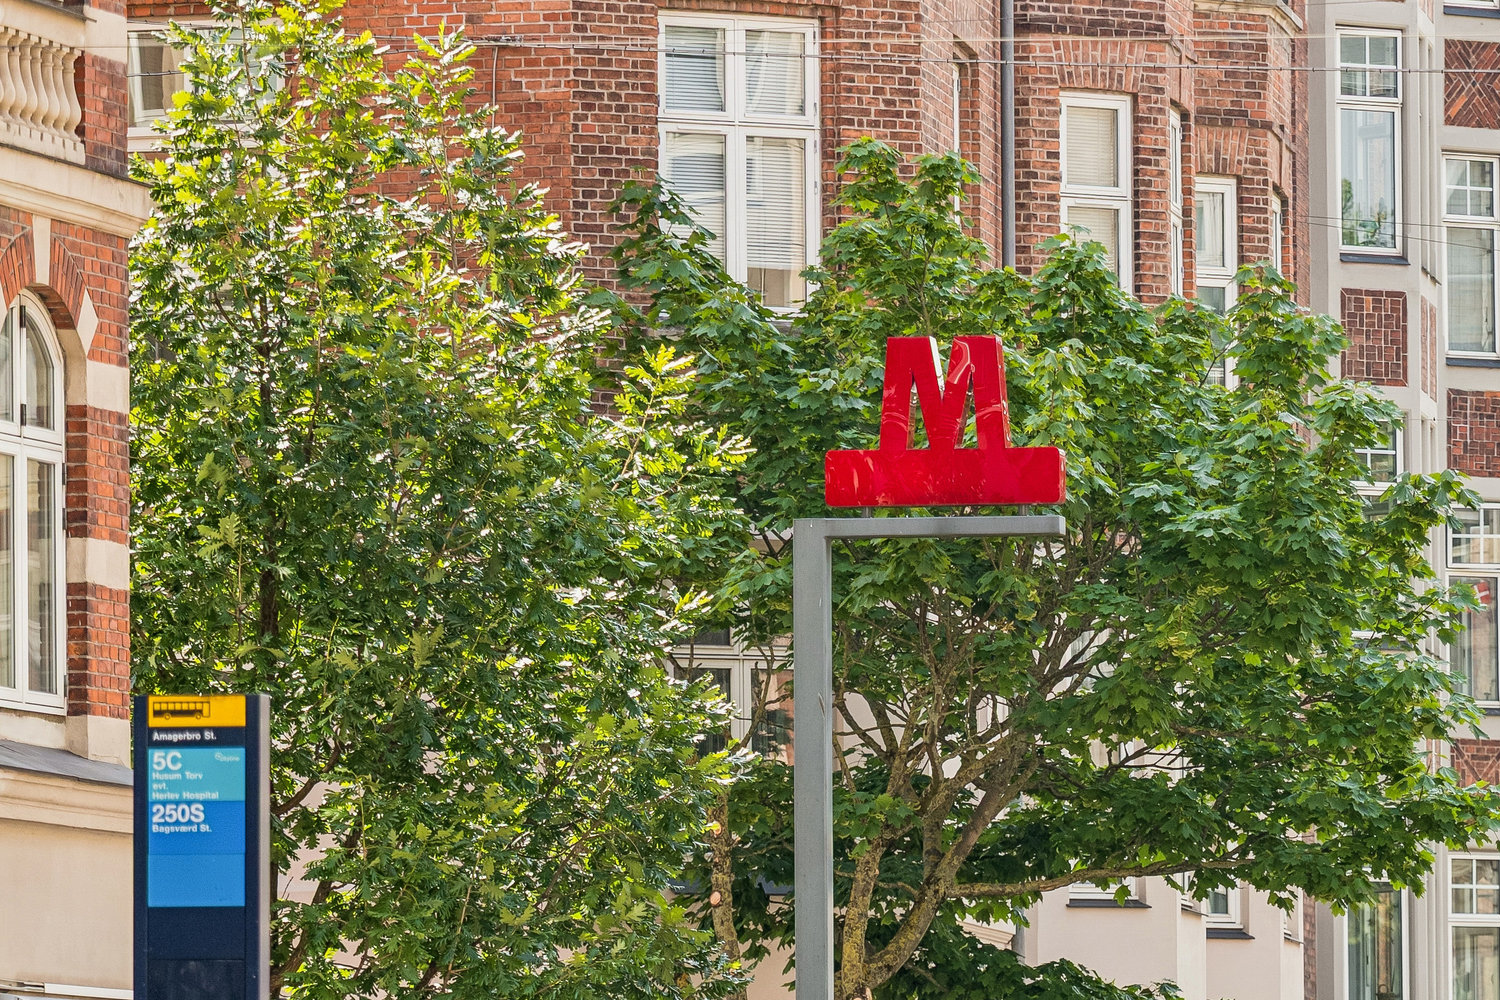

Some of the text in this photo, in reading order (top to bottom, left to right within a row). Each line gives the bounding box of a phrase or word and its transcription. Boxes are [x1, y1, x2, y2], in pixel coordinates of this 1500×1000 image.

[153, 731, 217, 742] Amagerbro St.
[152, 751, 182, 771] 5C
[152, 771, 203, 780] Husum Torv
[152, 791, 219, 801] Herlev Hospital
[152, 804, 205, 823] 250S
[152, 824, 212, 834] Bagsværd St.
